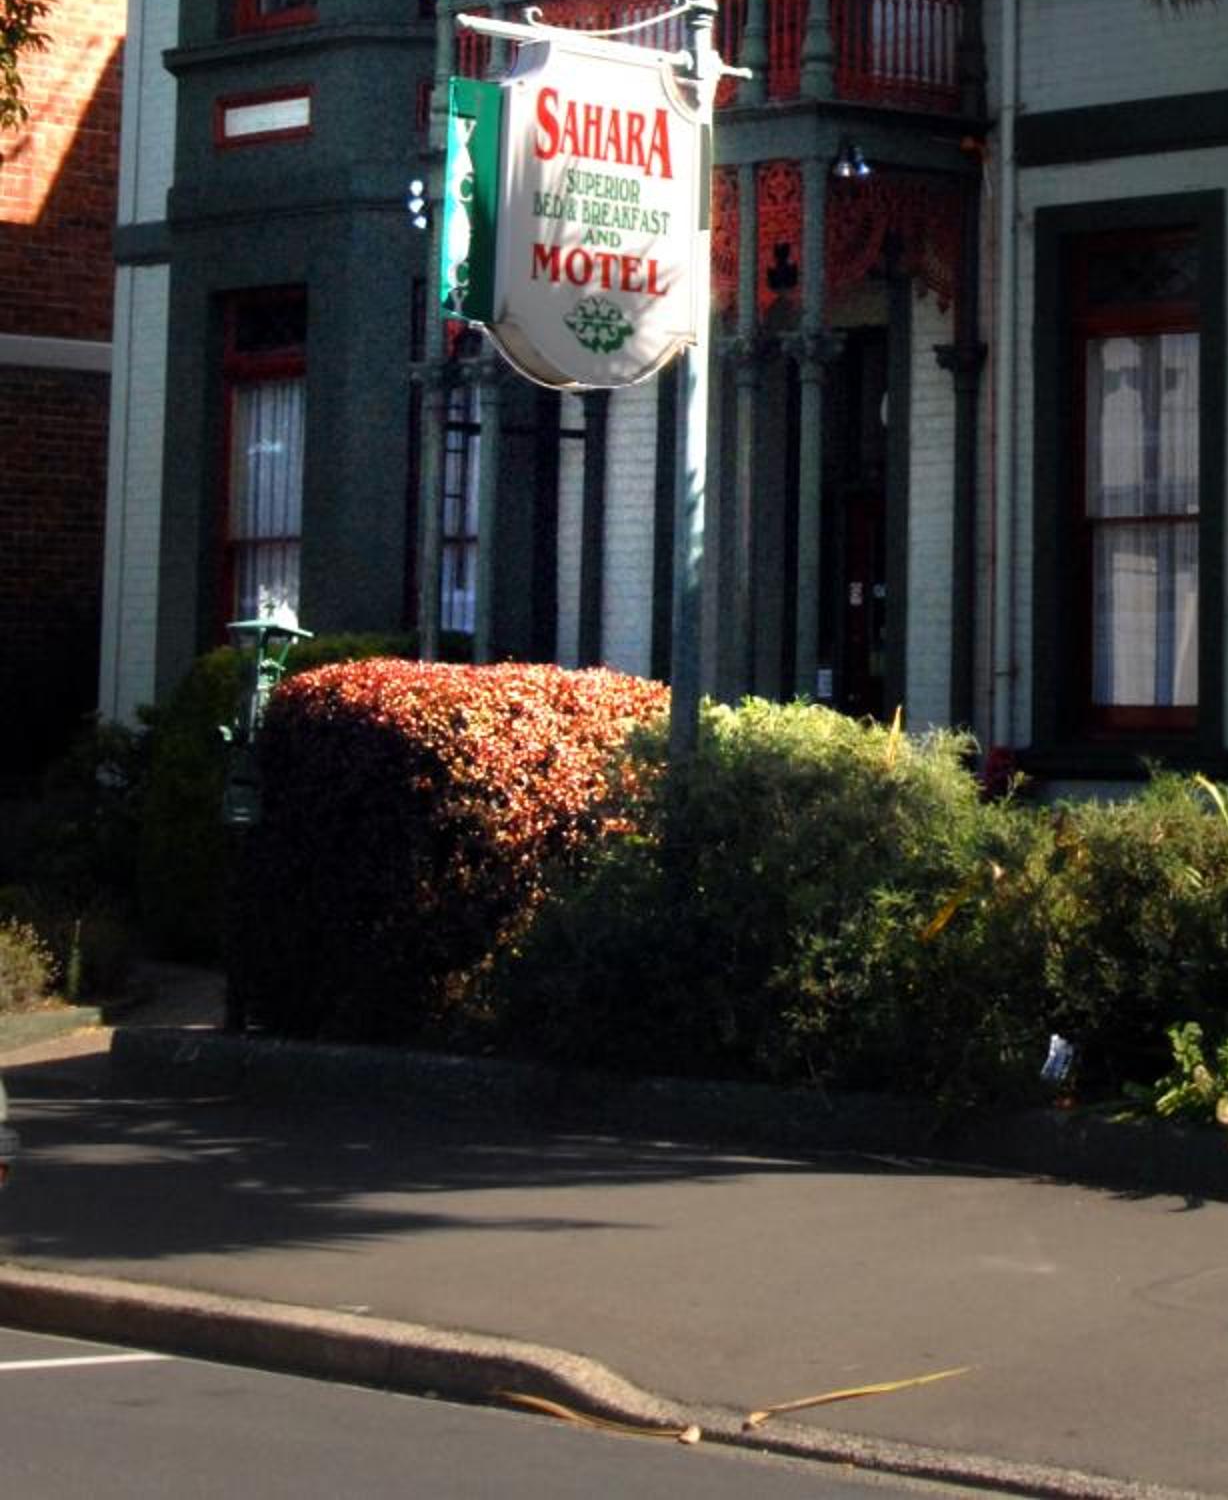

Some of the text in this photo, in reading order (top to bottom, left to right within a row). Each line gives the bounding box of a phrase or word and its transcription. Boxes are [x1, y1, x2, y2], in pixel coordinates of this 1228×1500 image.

[534, 87, 673, 179] SAHARA
[566, 168, 641, 204] SUPERIOR
[582, 200, 671, 235] BREAKFAST
[583, 228, 621, 248] AND
[531, 242, 669, 296] MOTEL
